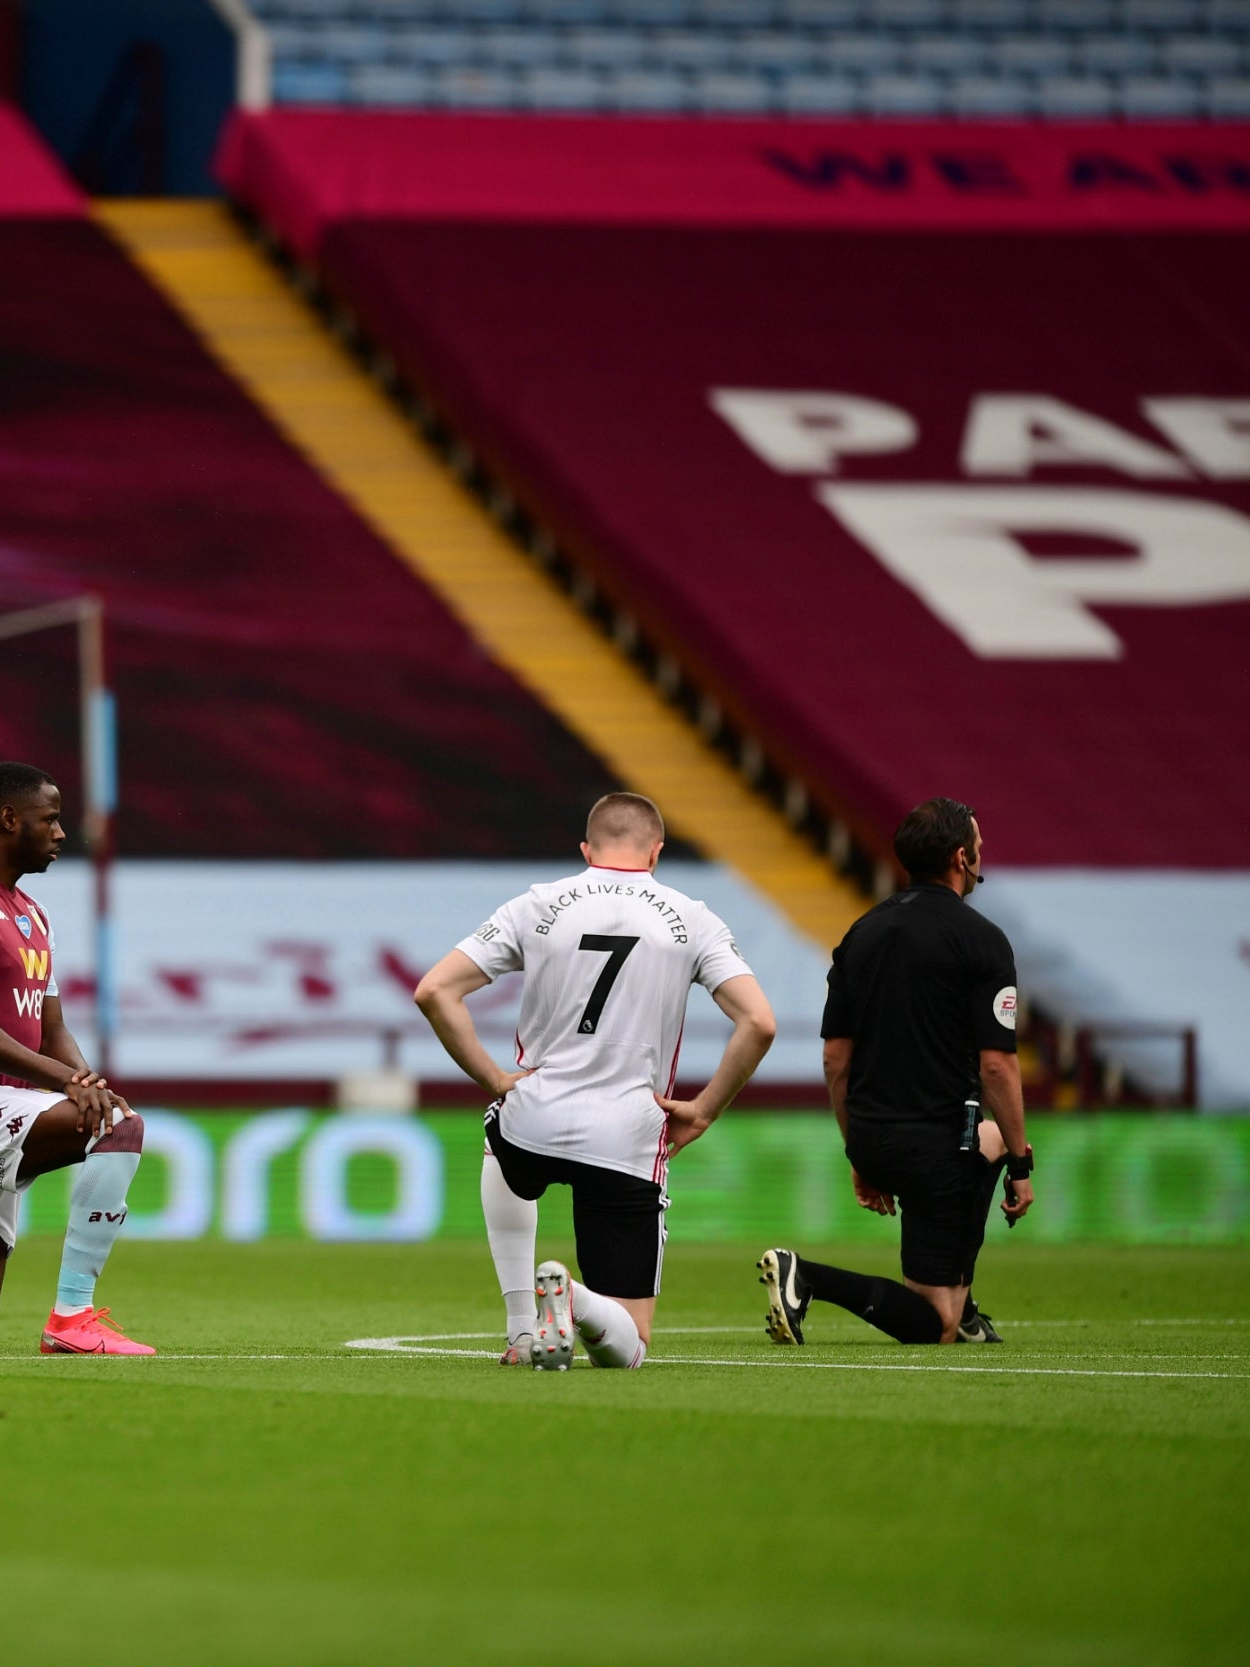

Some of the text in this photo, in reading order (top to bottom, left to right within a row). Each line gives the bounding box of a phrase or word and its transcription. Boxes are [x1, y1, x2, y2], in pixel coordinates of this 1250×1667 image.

[762, 149, 1026, 192] WE
[535, 883, 688, 944] BLACK LIVES MATTER
[577, 934, 641, 1034] 7
